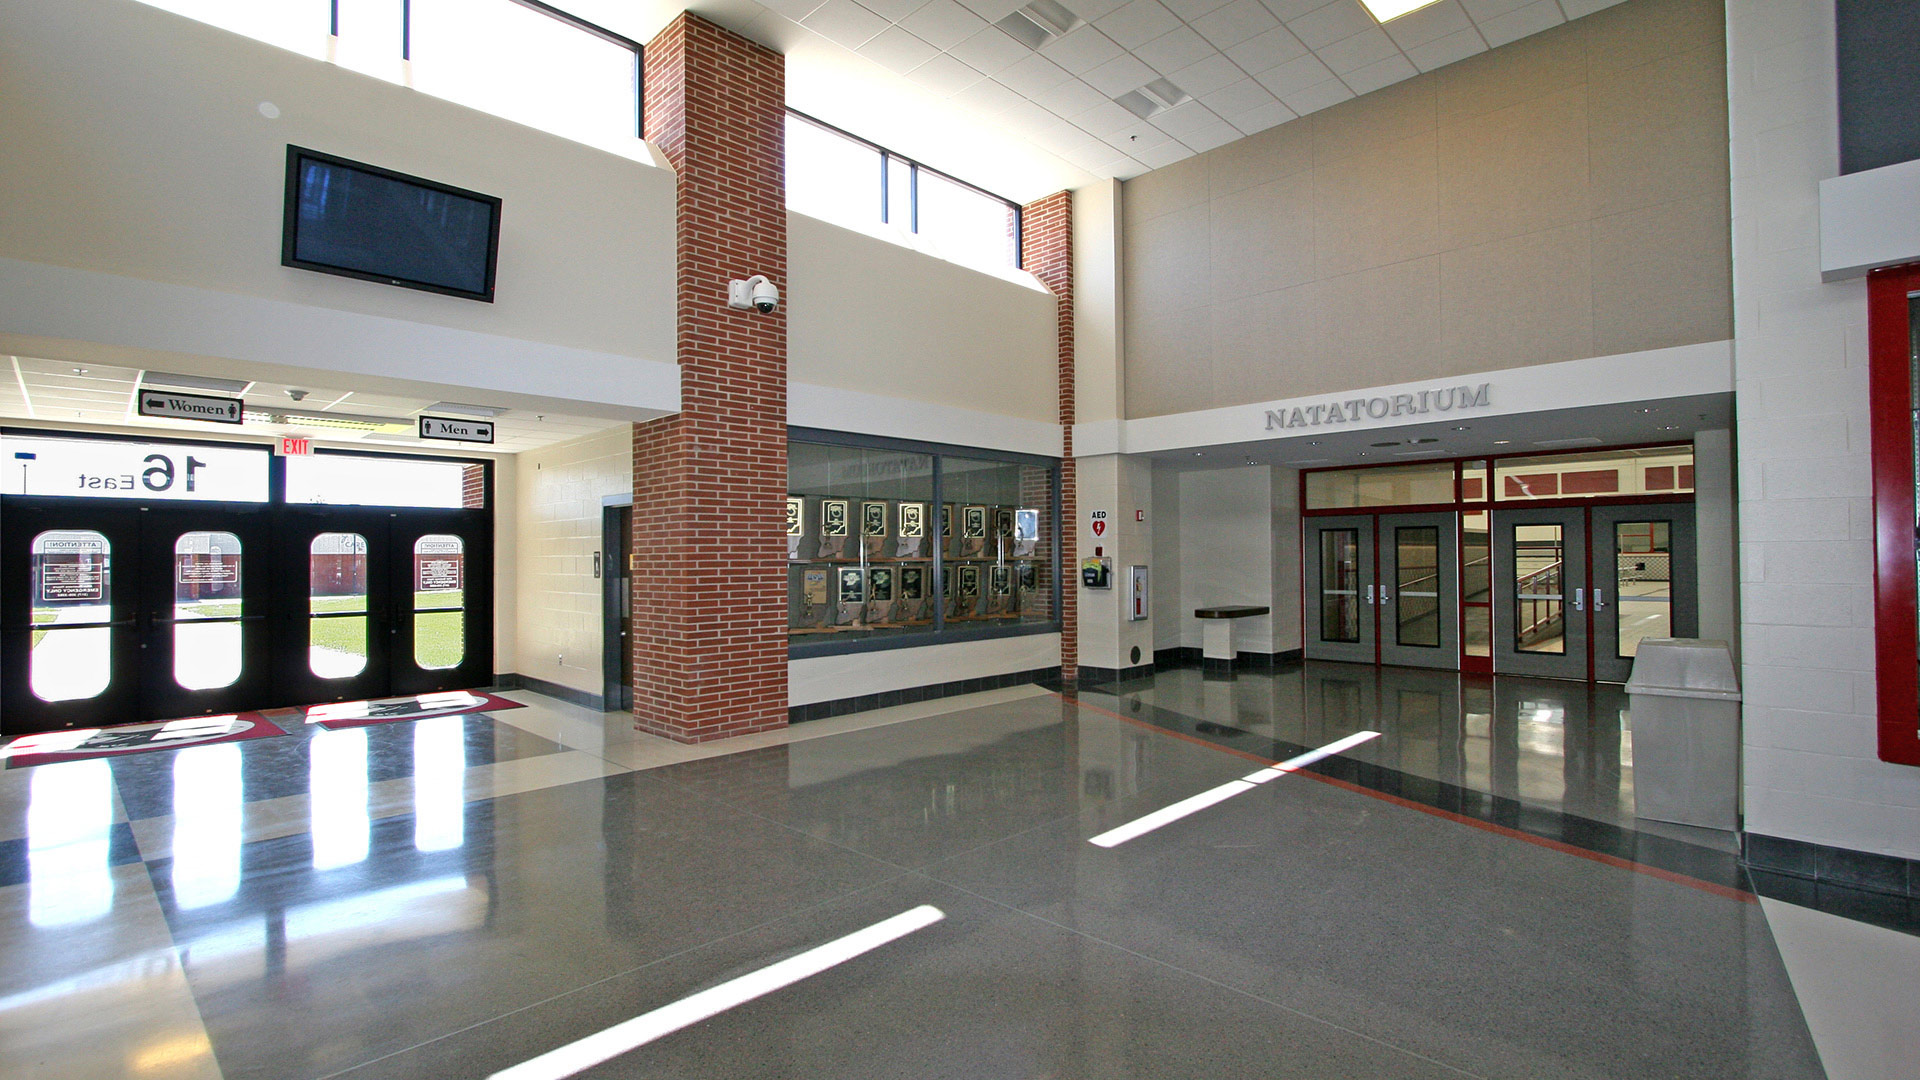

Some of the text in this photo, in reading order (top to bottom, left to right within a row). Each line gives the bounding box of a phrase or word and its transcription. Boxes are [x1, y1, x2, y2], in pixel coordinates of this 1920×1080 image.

[168, 399, 225, 415] Women
[1265, 382, 1491, 431] NATATORIUM
[440, 423, 468, 435] Men
[283, 438, 309, 455] EXIT
[1092, 511, 1107, 519] AED
